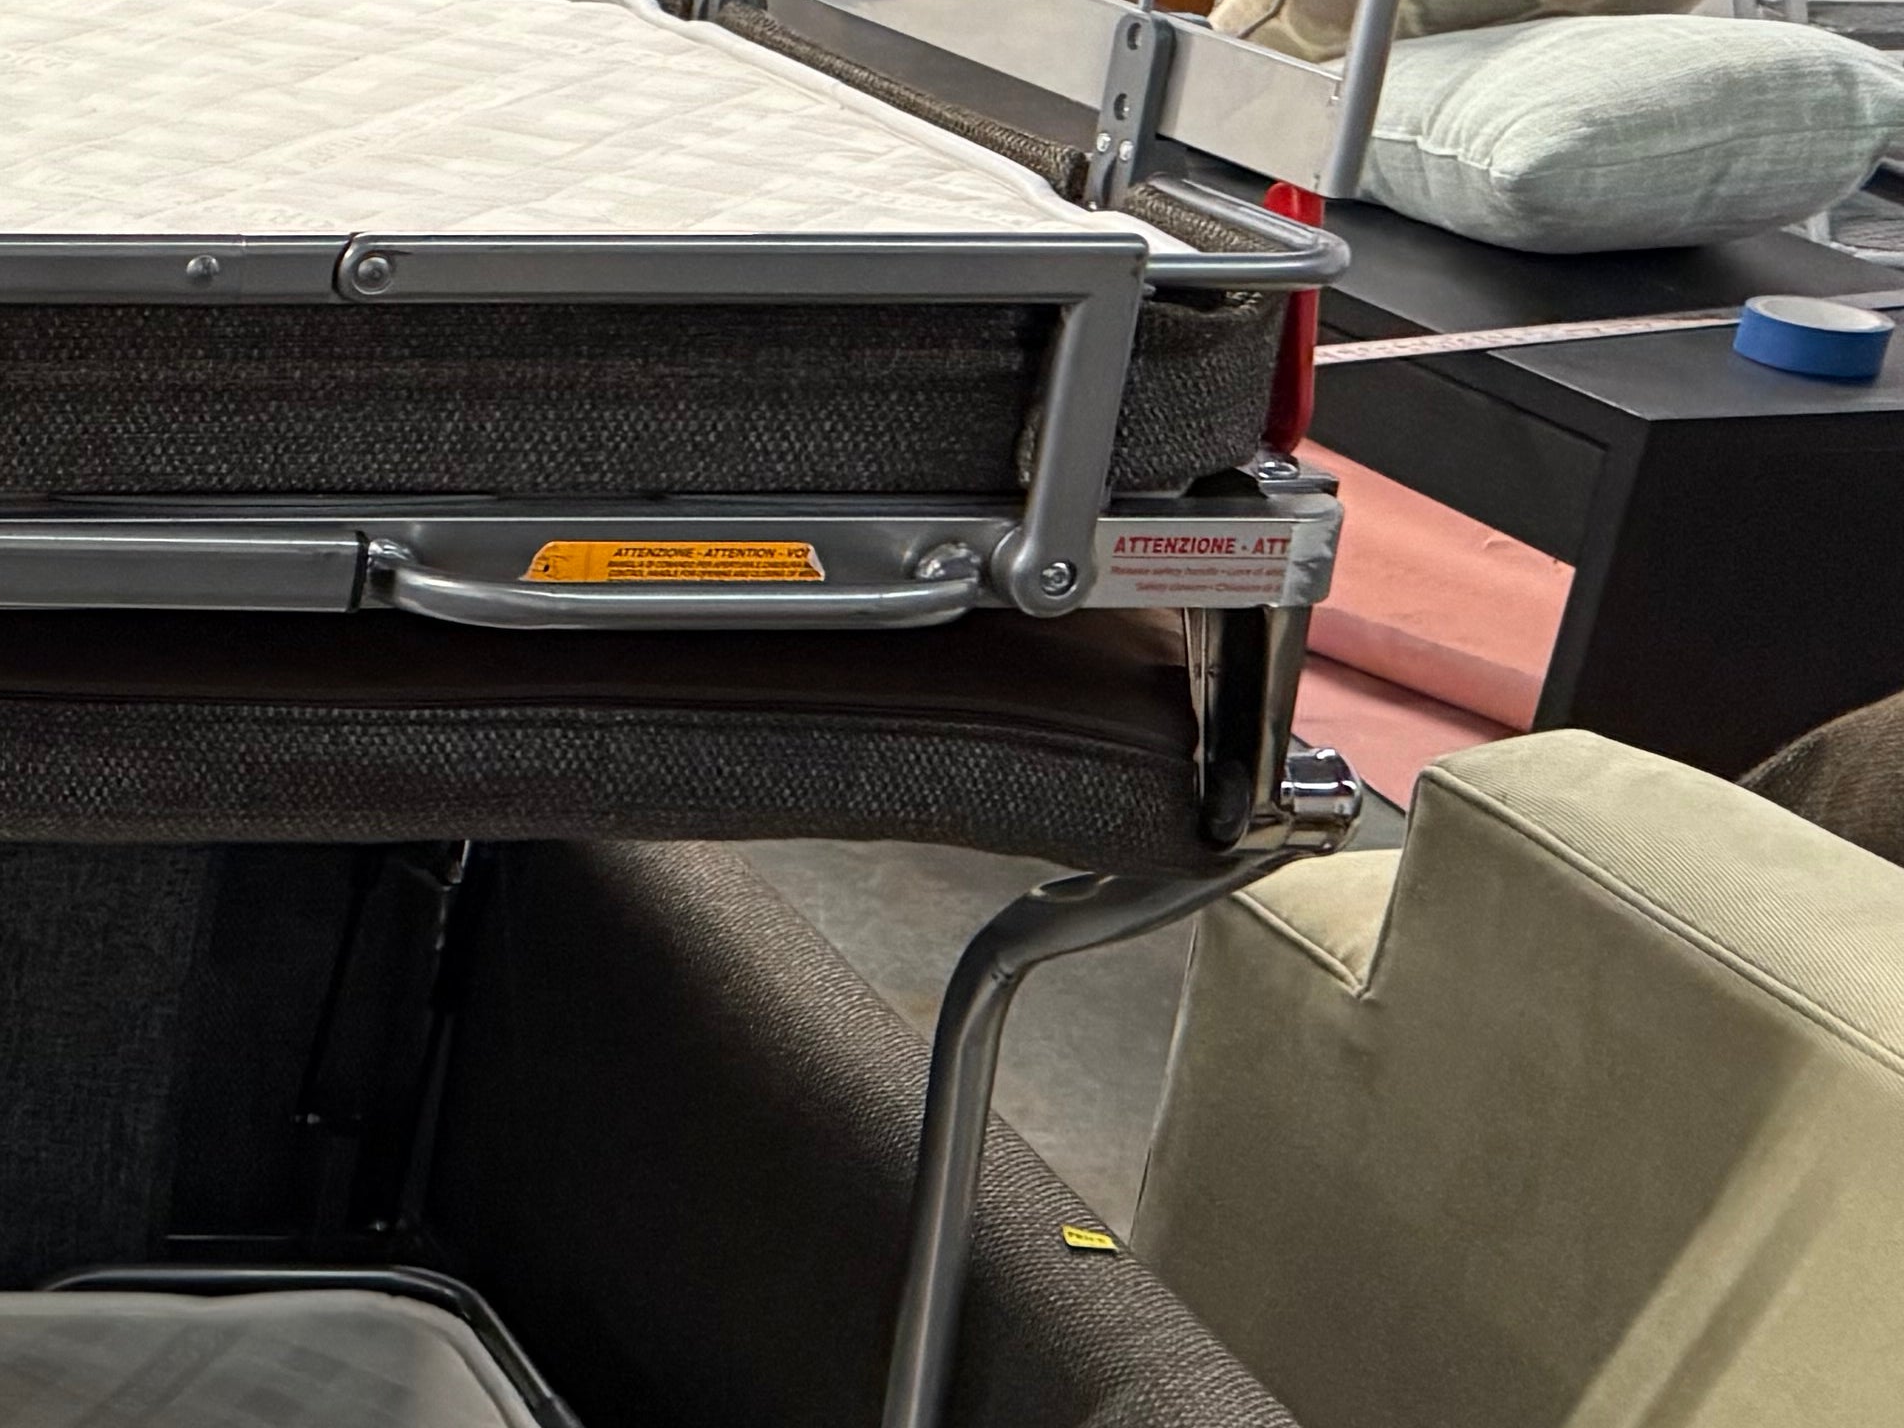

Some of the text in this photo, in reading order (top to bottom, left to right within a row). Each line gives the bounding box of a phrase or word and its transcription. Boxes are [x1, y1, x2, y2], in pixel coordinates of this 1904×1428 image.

[612, 547, 695, 559] ATTENZIONE
[704, 548, 776, 559] ATTENTION
[1114, 536, 1237, 555] ATTENZIONE
